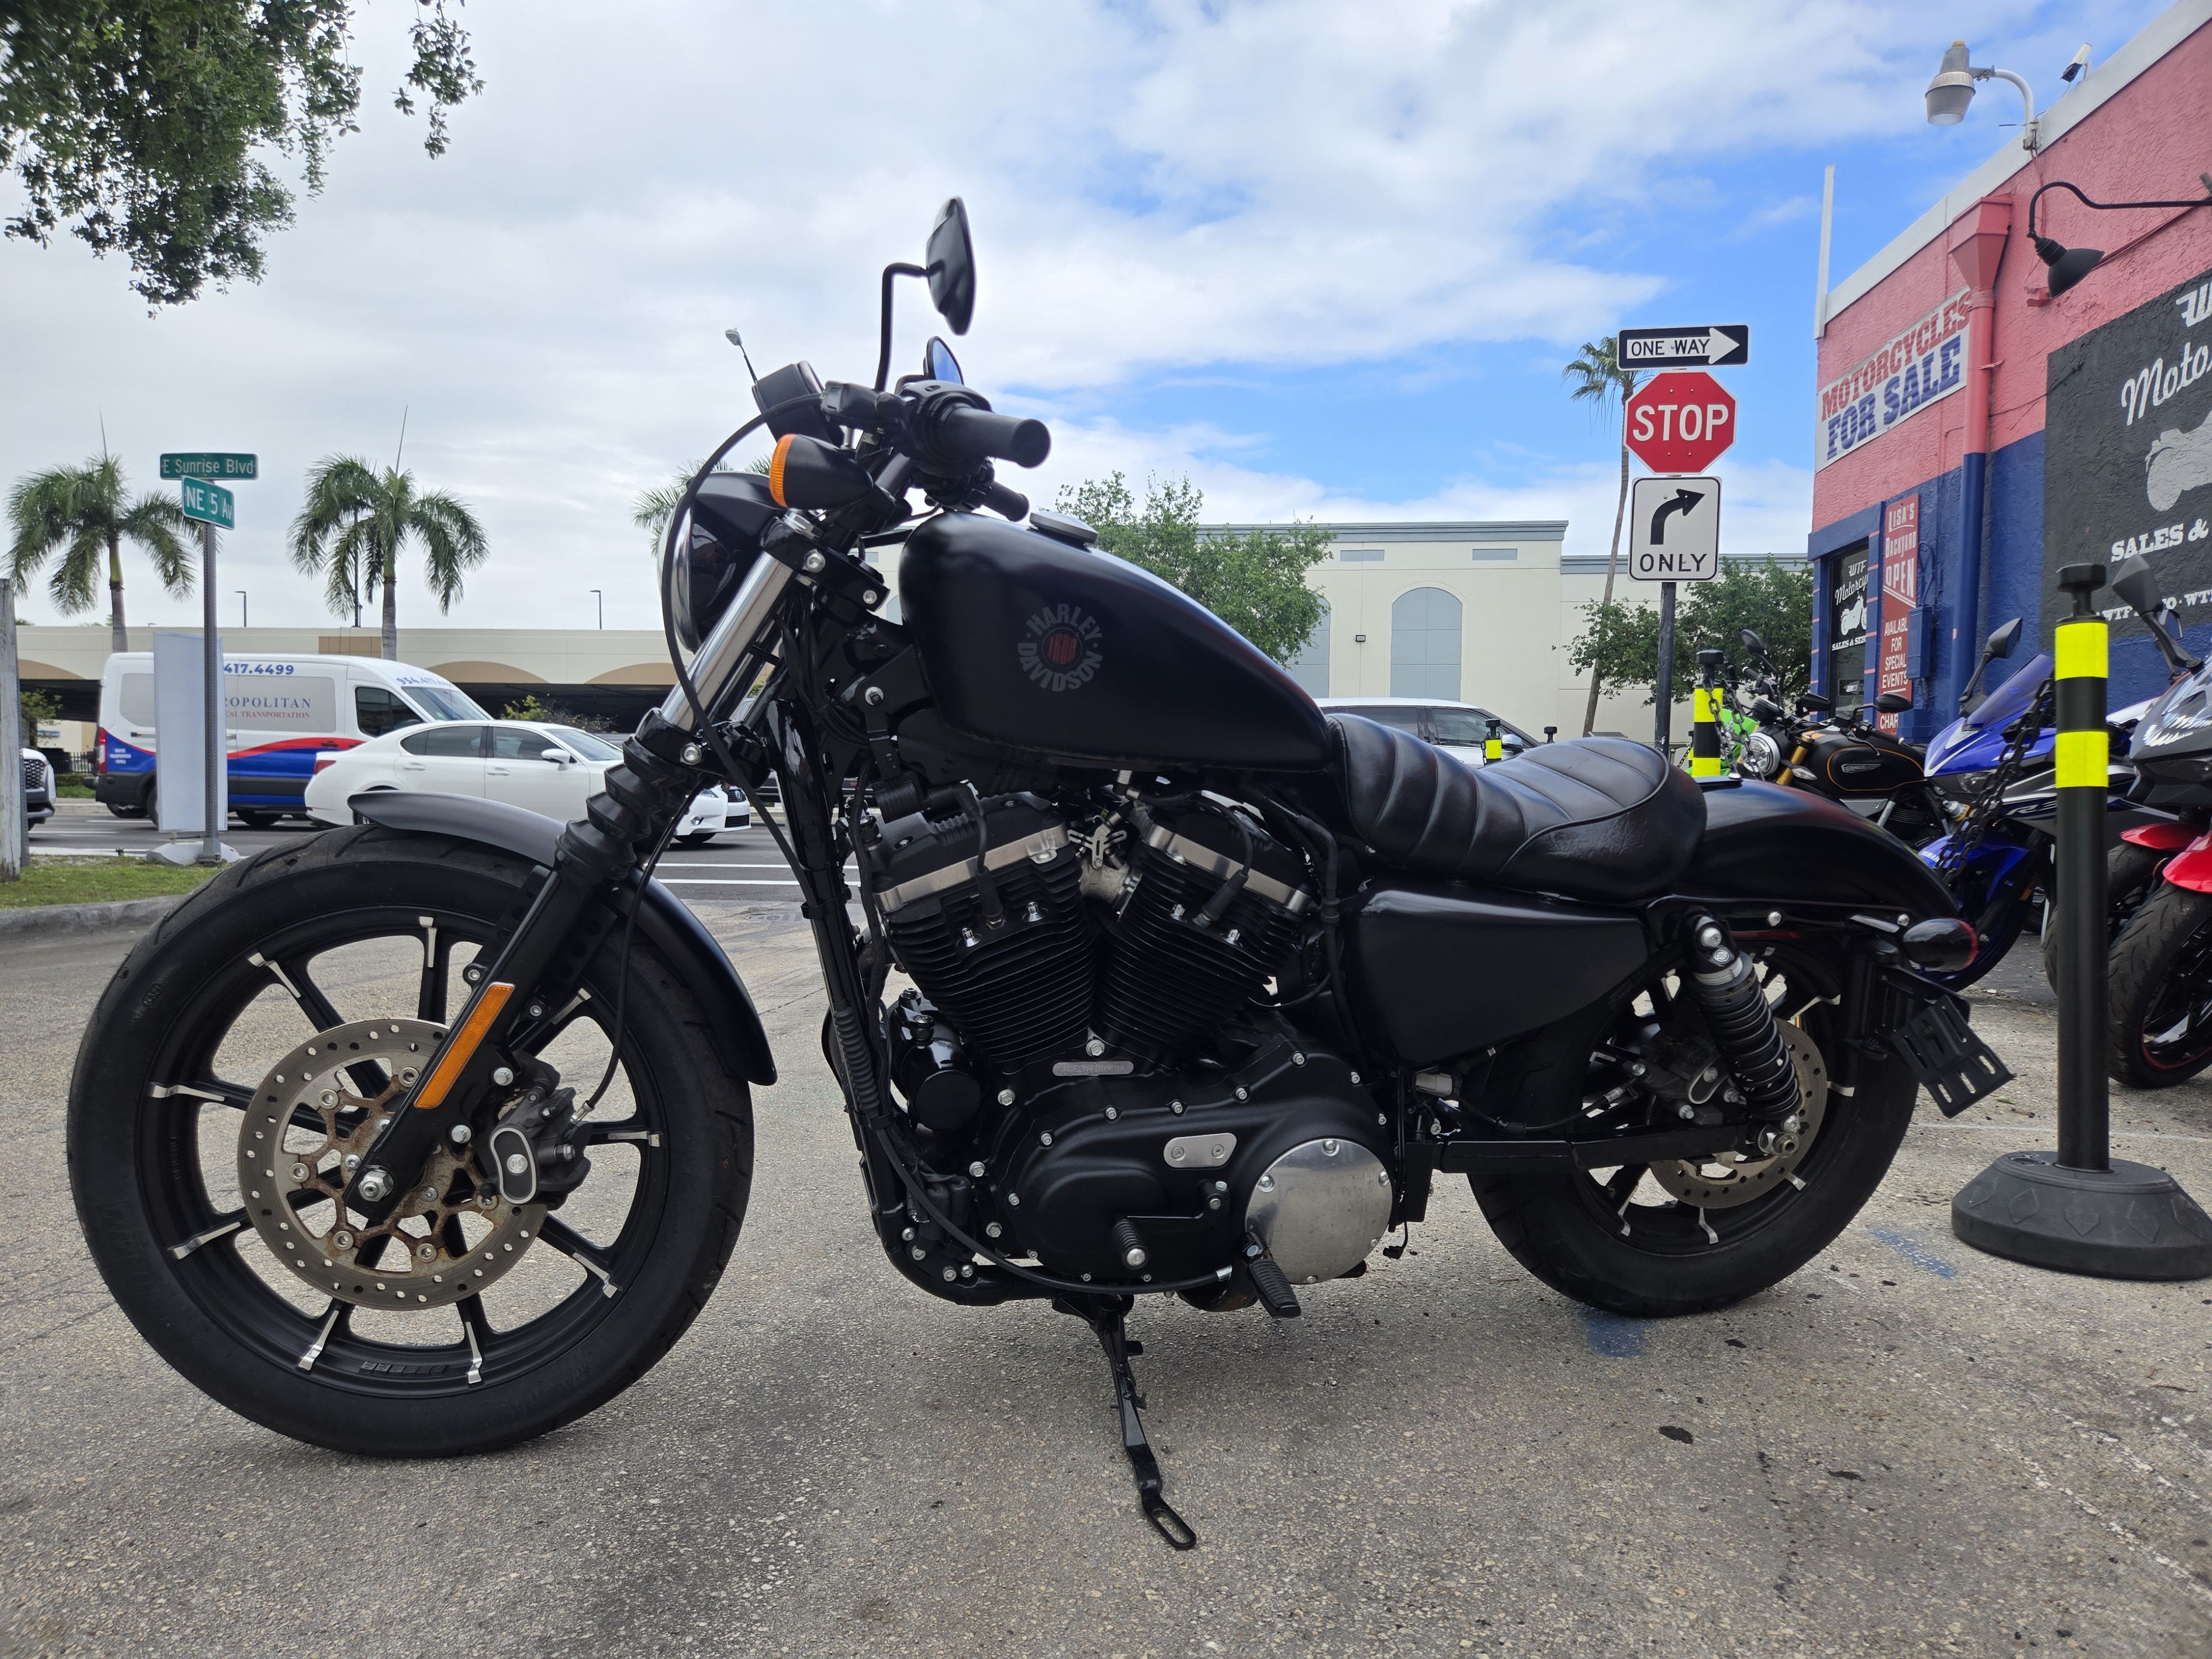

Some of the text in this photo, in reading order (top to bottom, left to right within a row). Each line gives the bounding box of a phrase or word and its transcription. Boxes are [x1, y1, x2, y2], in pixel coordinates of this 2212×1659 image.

[1631, 338, 1710, 356] ONE WAY
[1822, 291, 1971, 421] MOTORCYCLES
[2121, 342, 2212, 426] Moto
[1827, 335, 1961, 461] FOR SALE
[1632, 404, 1729, 441] STOP
[163, 459, 253, 474] E Sunrise Blvd
[186, 486, 205, 512] NE
[211, 493, 218, 515] 5
[2111, 519, 2209, 562] SALES &
[1640, 554, 1707, 572] ONLY
[1848, 560, 1867, 576] WTF
[1886, 557, 1914, 598] OPEN
[1835, 572, 1869, 605] Motorcy
[2184, 589, 2212, 607] WT
[1026, 603, 1103, 640] HARLEY
[1884, 617, 1908, 637] AVAILABL
[1832, 640, 1849, 651] SALES
[1855, 635, 1866, 645] SER
[1891, 637, 1902, 653] FOR
[224, 664, 294, 675] 417.4499
[1018, 643, 1103, 692] DAVIDSON
[1885, 653, 1906, 671] SPECIAL
[1882, 671, 1908, 688] EVENTS
[225, 697, 311, 708] OPOLITAN
[241, 711, 310, 719] TRANSPORTATION
[1880, 713, 1898, 729] CHAR
[1920, 851, 1940, 863] YAMAH
